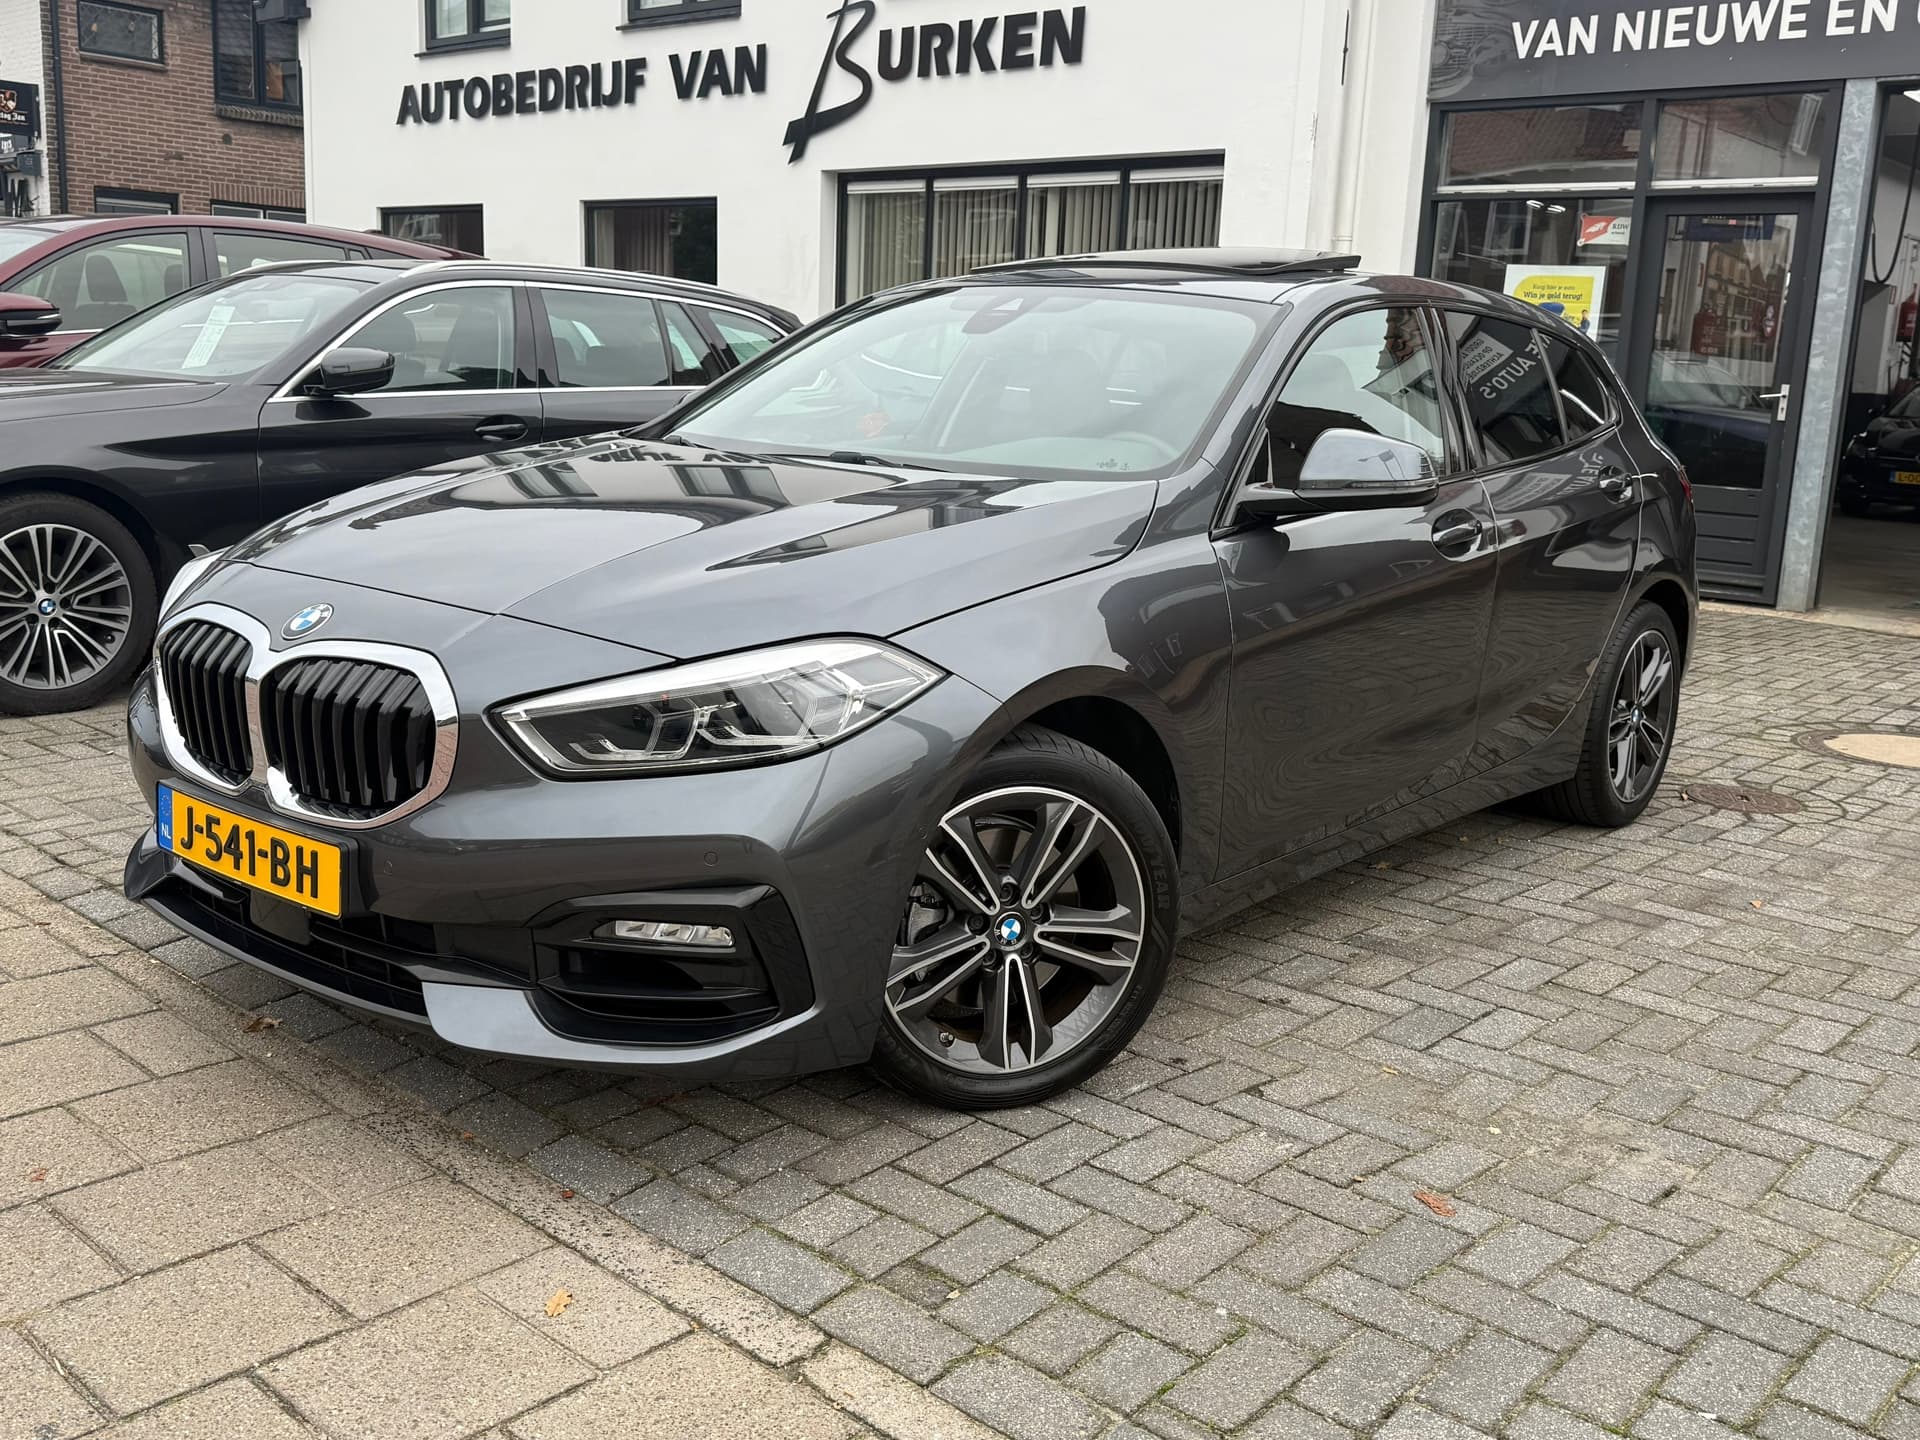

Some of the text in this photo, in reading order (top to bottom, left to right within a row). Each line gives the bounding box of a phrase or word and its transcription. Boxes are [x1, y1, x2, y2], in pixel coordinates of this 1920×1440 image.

[1511, 0, 1899, 59] VAN NIEUWE EN
[396, 57, 647, 126] AUTOBEDRIJF
[668, 43, 767, 100] VAN
[1546, 292, 1561, 300] geld
[1562, 293, 1583, 301] terug!
[161, 824, 172, 839] NL
[180, 806, 319, 899] J-541-BH
